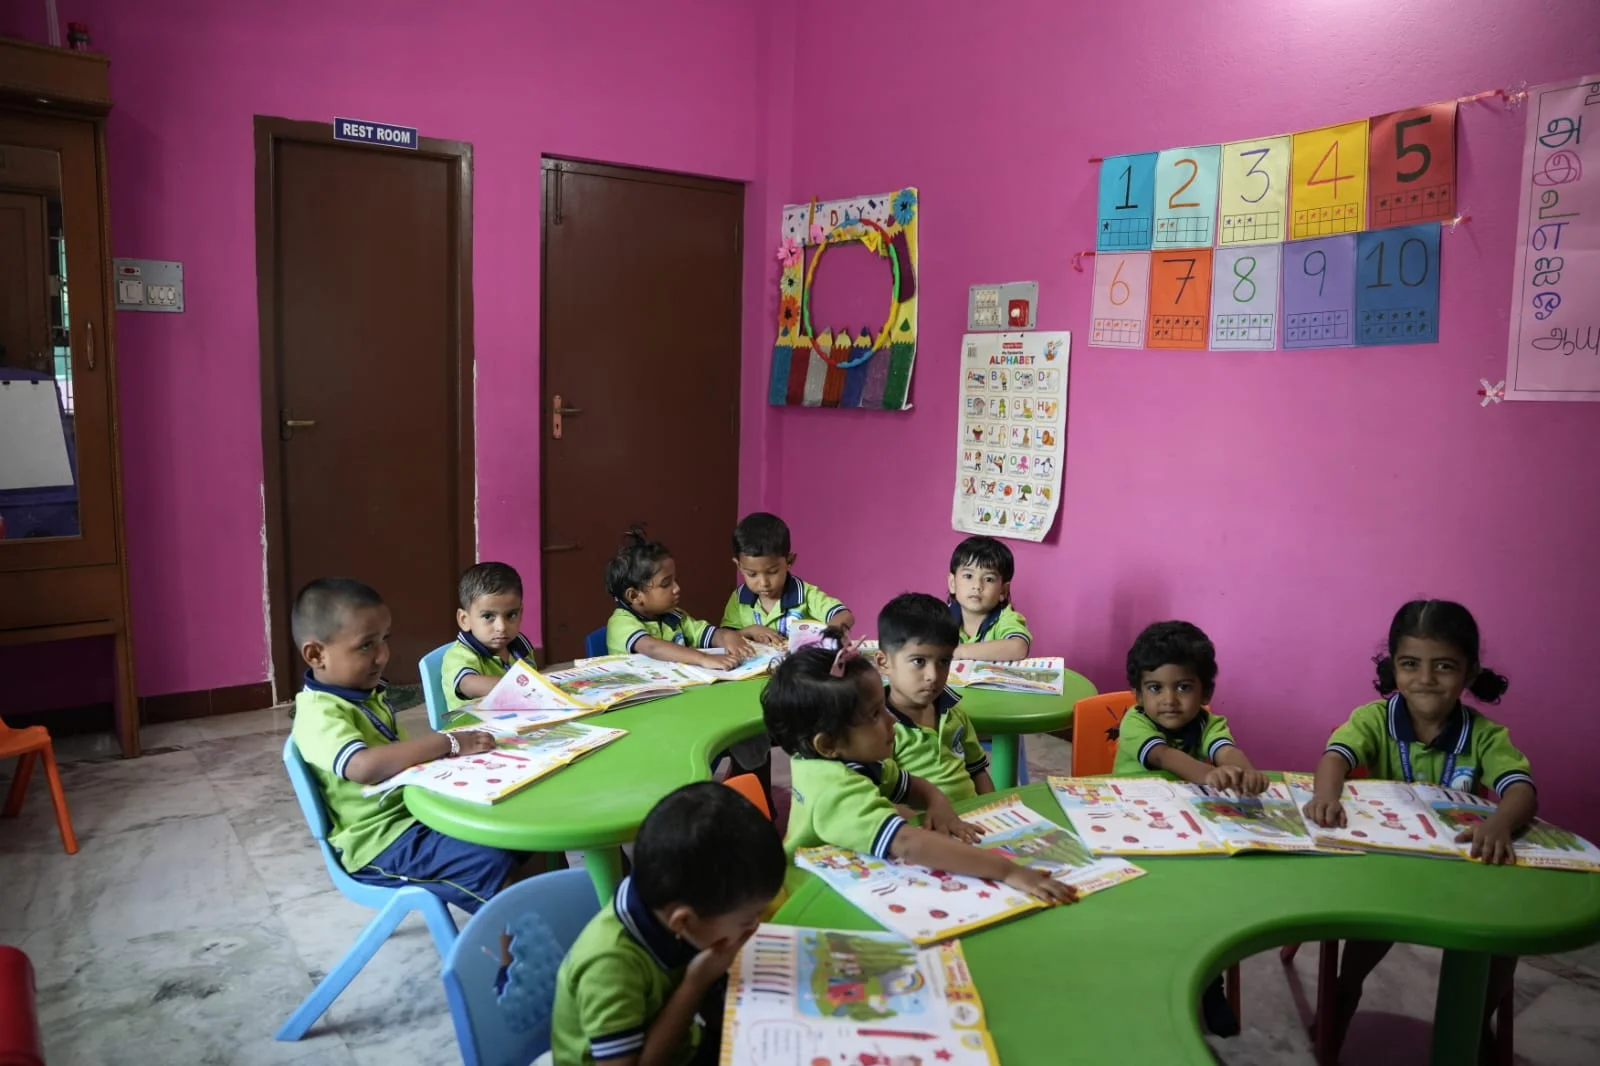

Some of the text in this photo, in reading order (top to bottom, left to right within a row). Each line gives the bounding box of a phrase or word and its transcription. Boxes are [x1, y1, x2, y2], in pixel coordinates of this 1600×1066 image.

[343, 123, 410, 144] REST ROOM
[1396, 115, 1432, 183] 5
[1538, 115, 1582, 148] அ
[1115, 165, 1138, 210] 1
[1169, 158, 1200, 209] 2
[1240, 148, 1270, 203] 3
[1307, 140, 1355, 200] 4
[830, 206, 865, 227] DAY
[1538, 189, 1580, 220] உ
[1532, 222, 1569, 251] எ
[1109, 260, 1130, 306] 6
[1163, 258, 1196, 304] 7
[1232, 256, 1257, 303] 8
[1303, 250, 1327, 297] 9
[1365, 238, 1429, 289] 10
[1532, 256, 1564, 287] ஐ
[989, 355, 1035, 365] ALPHABET
